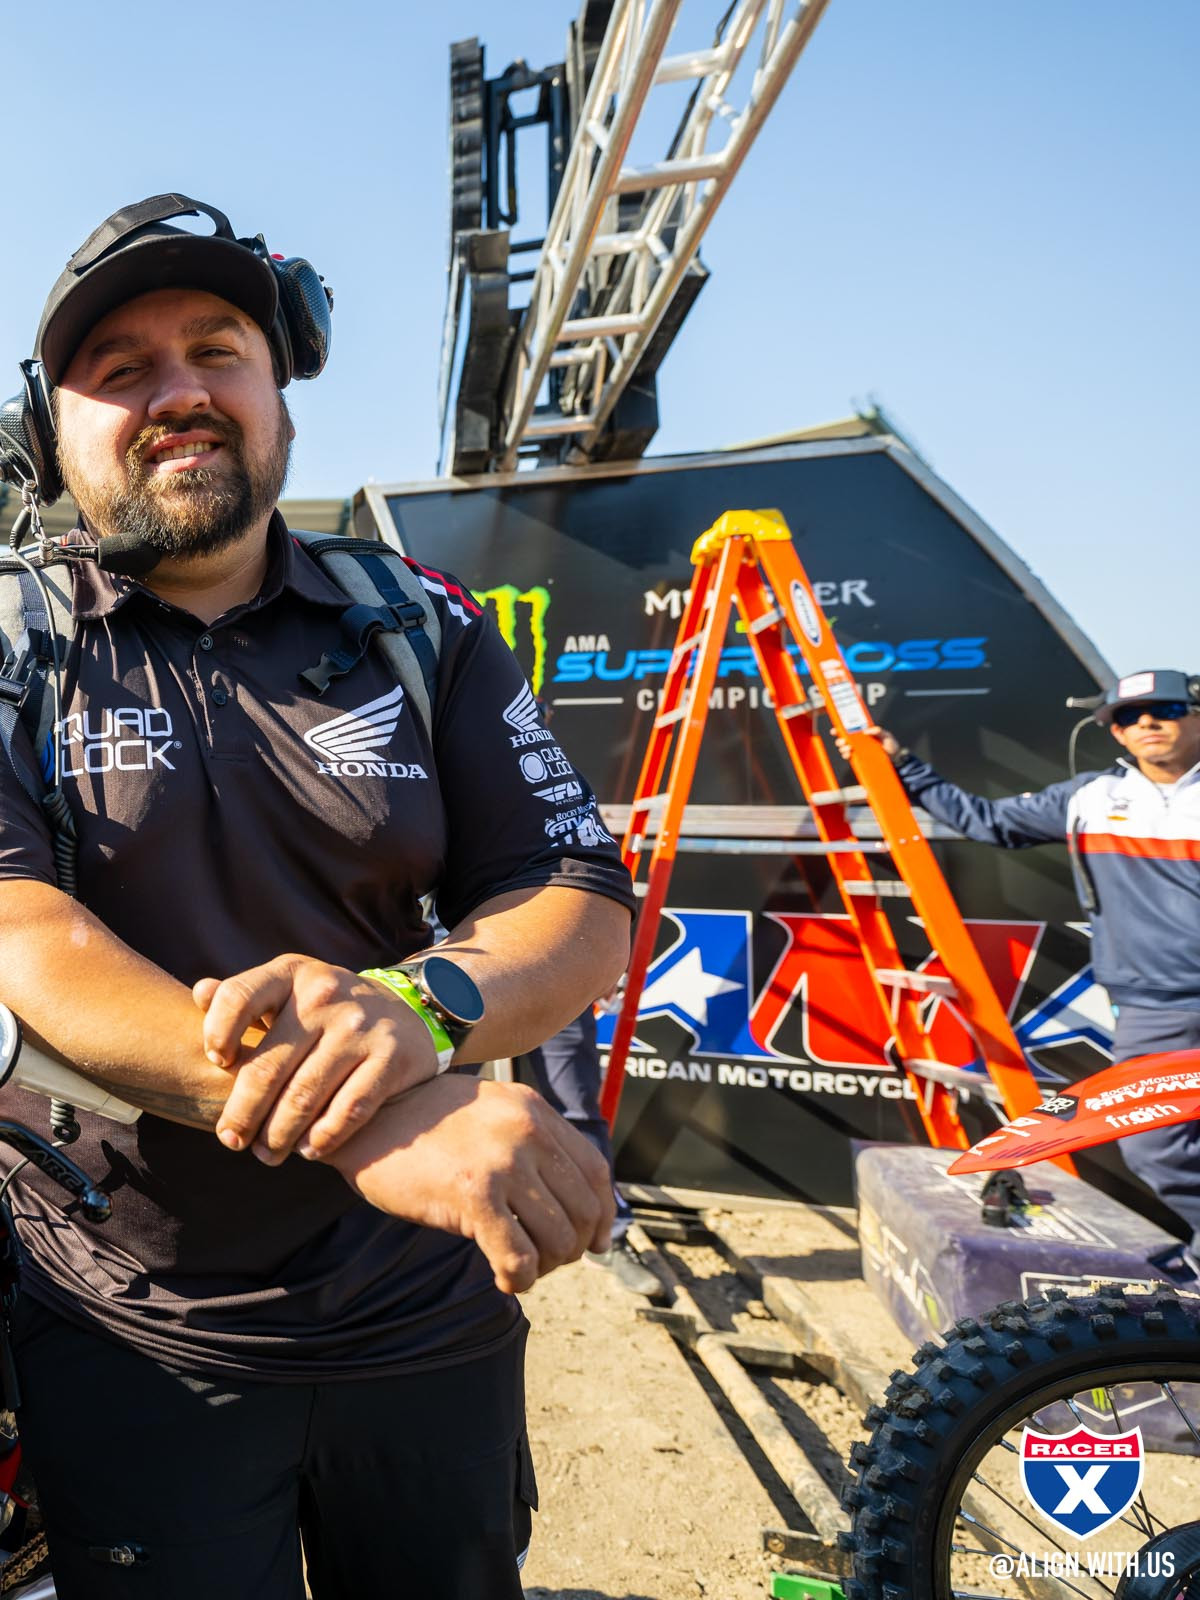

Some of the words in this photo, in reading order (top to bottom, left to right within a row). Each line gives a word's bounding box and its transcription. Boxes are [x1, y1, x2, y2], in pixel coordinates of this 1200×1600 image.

[564, 634, 610, 653] AMA
[552, 636, 989, 683] SUPROSS
[61, 708, 173, 746] QUAD
[509, 729, 555, 748] HOND
[61, 740, 175, 778] LOCK
[315, 760, 429, 779] HONDA
